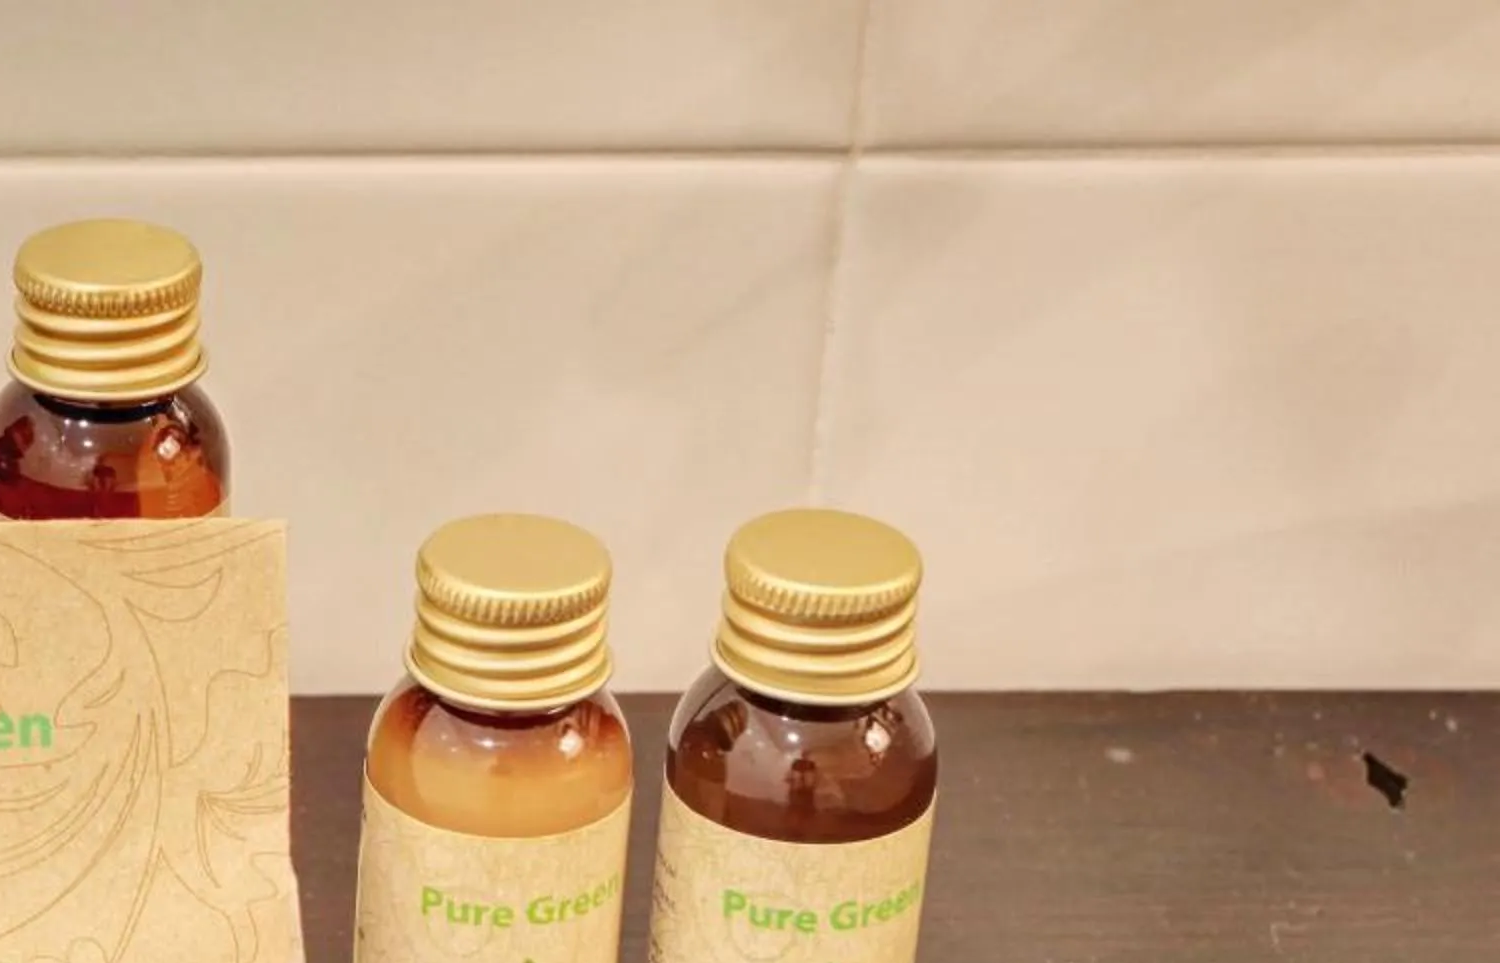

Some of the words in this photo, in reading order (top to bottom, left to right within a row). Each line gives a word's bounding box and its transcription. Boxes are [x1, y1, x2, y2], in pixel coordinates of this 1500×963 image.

[422, 885, 514, 927] Pure
[527, 873, 619, 925] Green
[722, 889, 818, 933] Pure
[829, 881, 920, 931] Green
